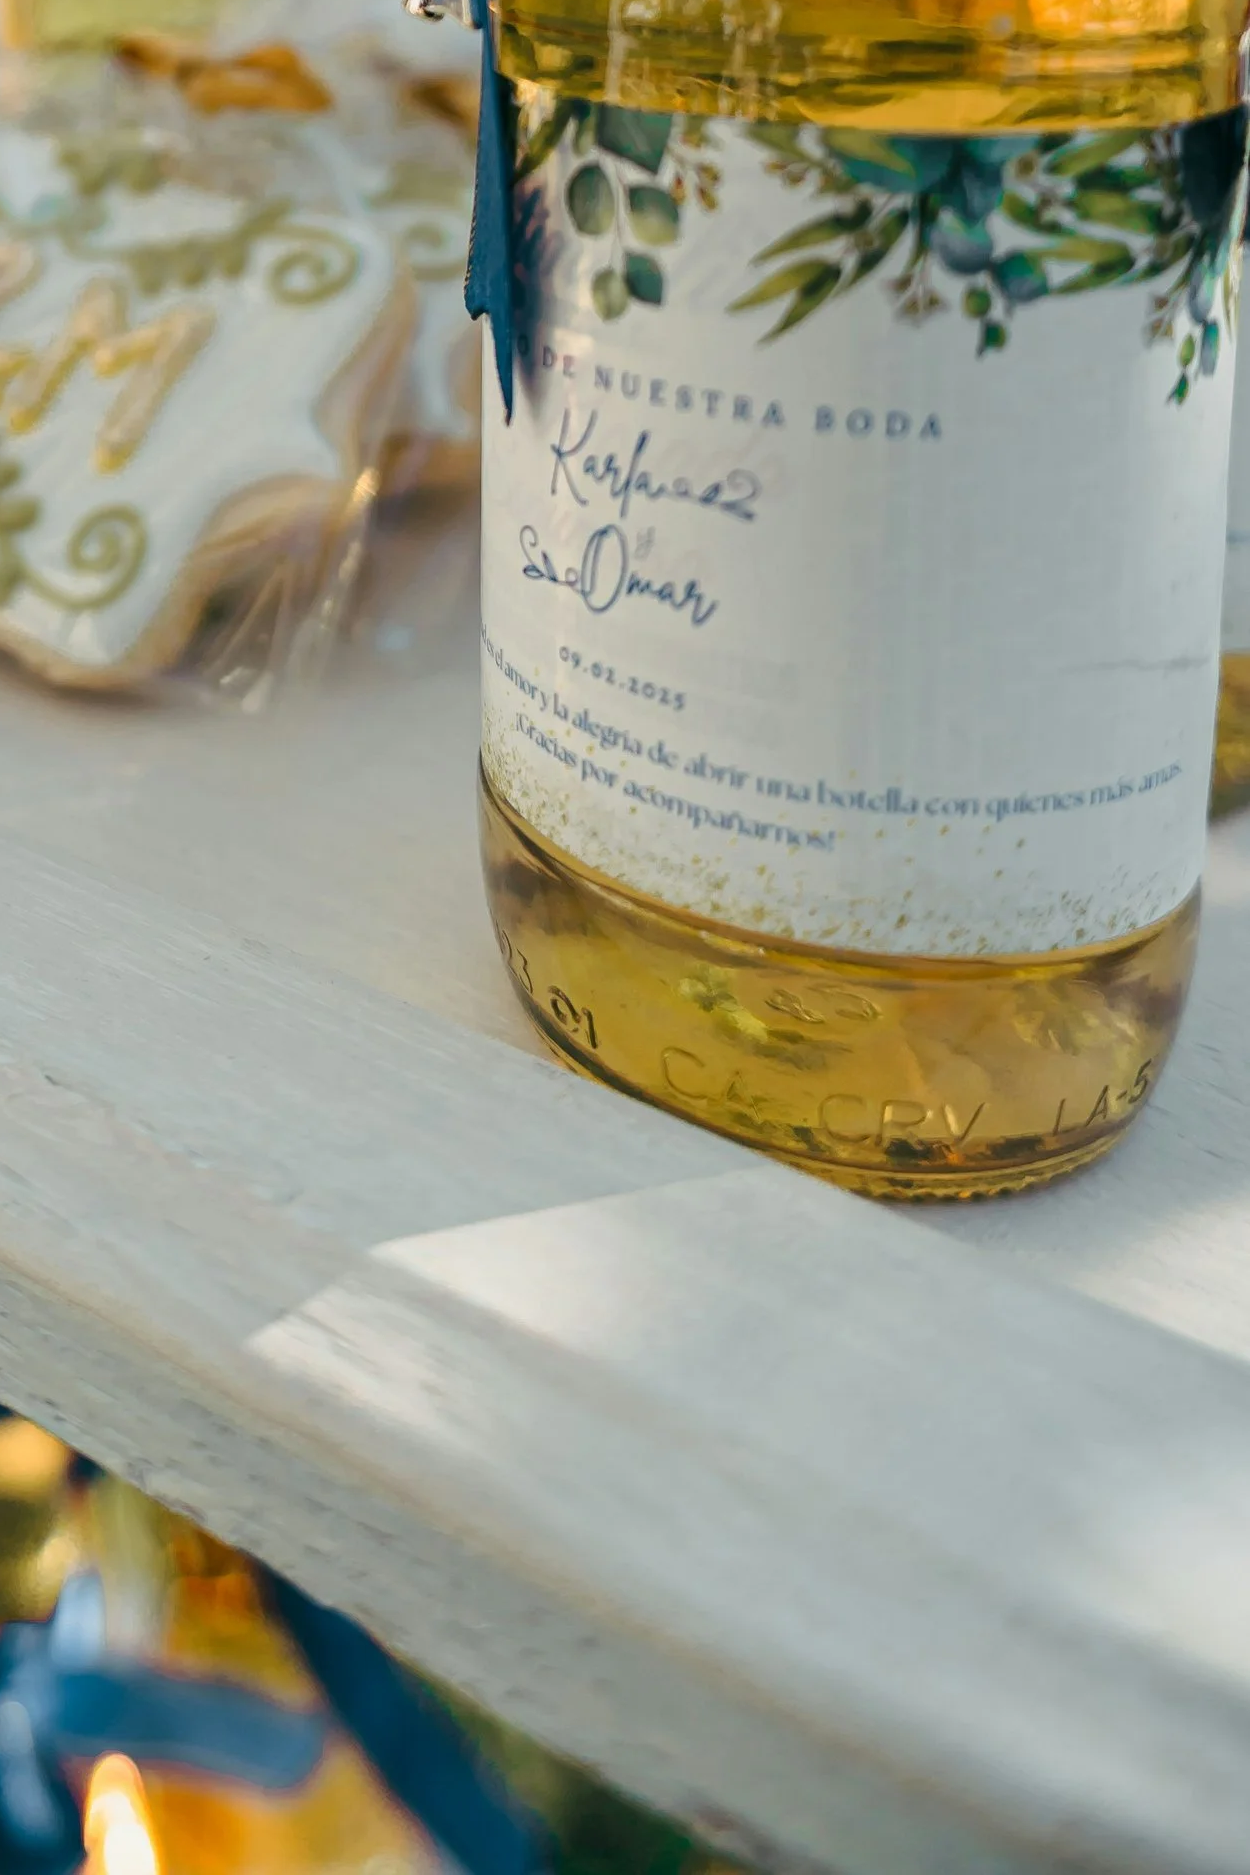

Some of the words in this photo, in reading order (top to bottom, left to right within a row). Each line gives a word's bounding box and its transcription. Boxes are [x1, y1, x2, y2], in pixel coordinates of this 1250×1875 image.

[543, 345, 577, 377] DE
[594, 364, 786, 429] NUESTRA
[814, 403, 943, 442] BODA
[519, 523, 721, 627] Omar
[504, 661, 539, 700] amor
[553, 692, 569, 722] la
[648, 739, 679, 770] de
[683, 752, 750, 790] abrir
[816, 778, 920, 814] botella
[923, 796, 981, 817] con
[985, 791, 1086, 824] quienes
[580, 758, 619, 789] por
